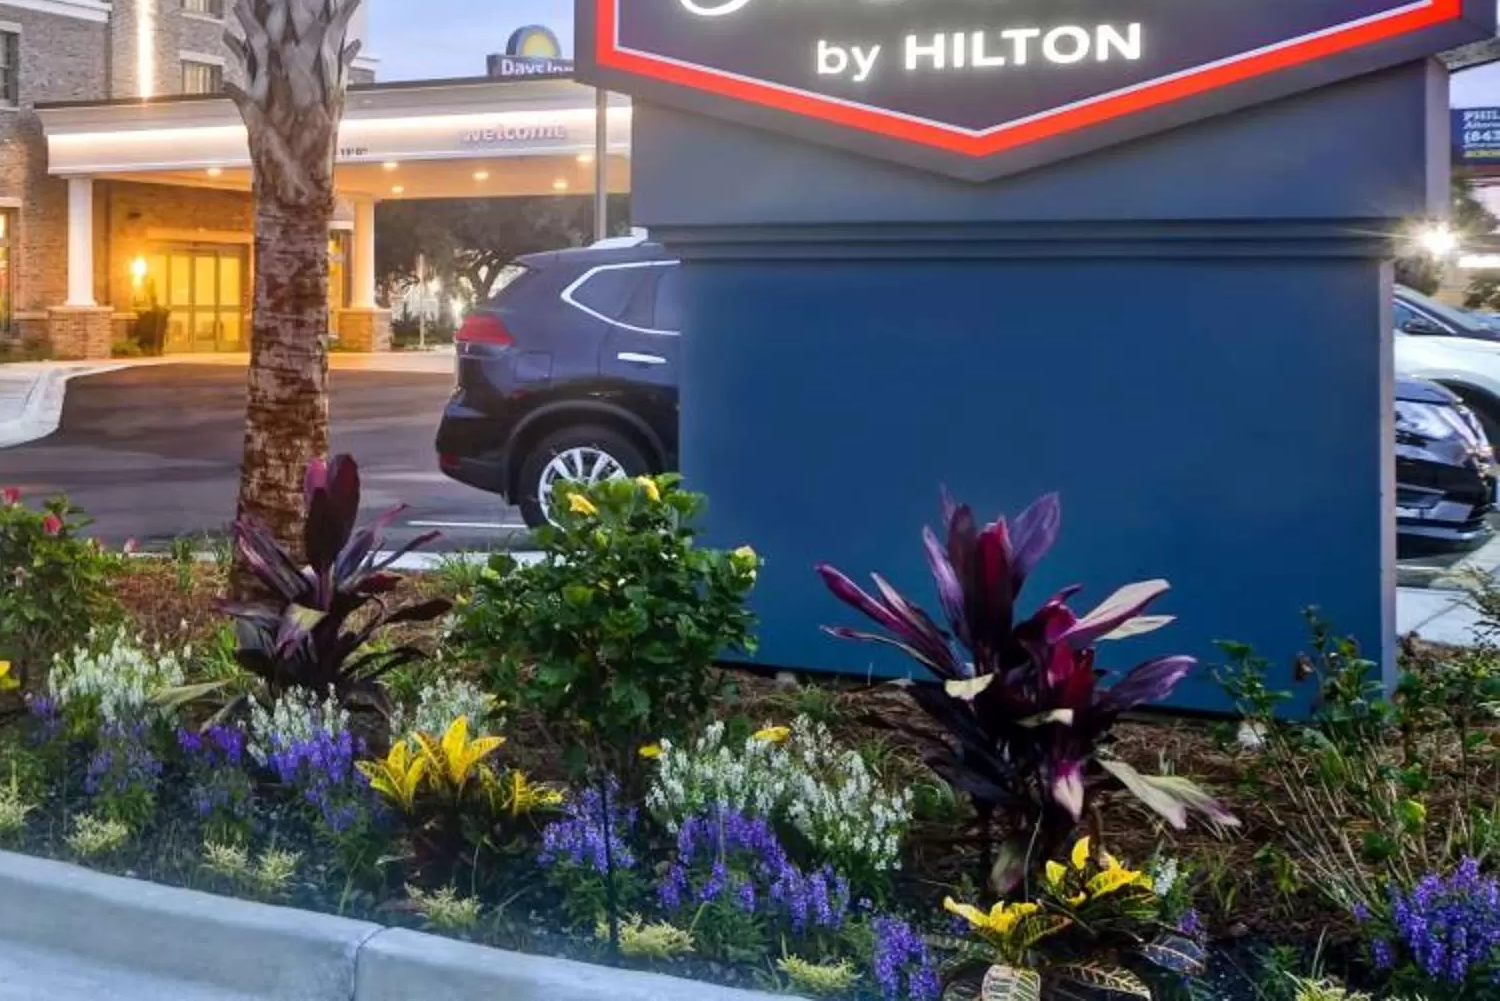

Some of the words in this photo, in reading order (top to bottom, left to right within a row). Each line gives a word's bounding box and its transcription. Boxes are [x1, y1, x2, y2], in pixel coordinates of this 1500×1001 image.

[816, 38, 880, 81] by
[904, 22, 1142, 70] HILTON
[461, 122, 566, 143] welcome
